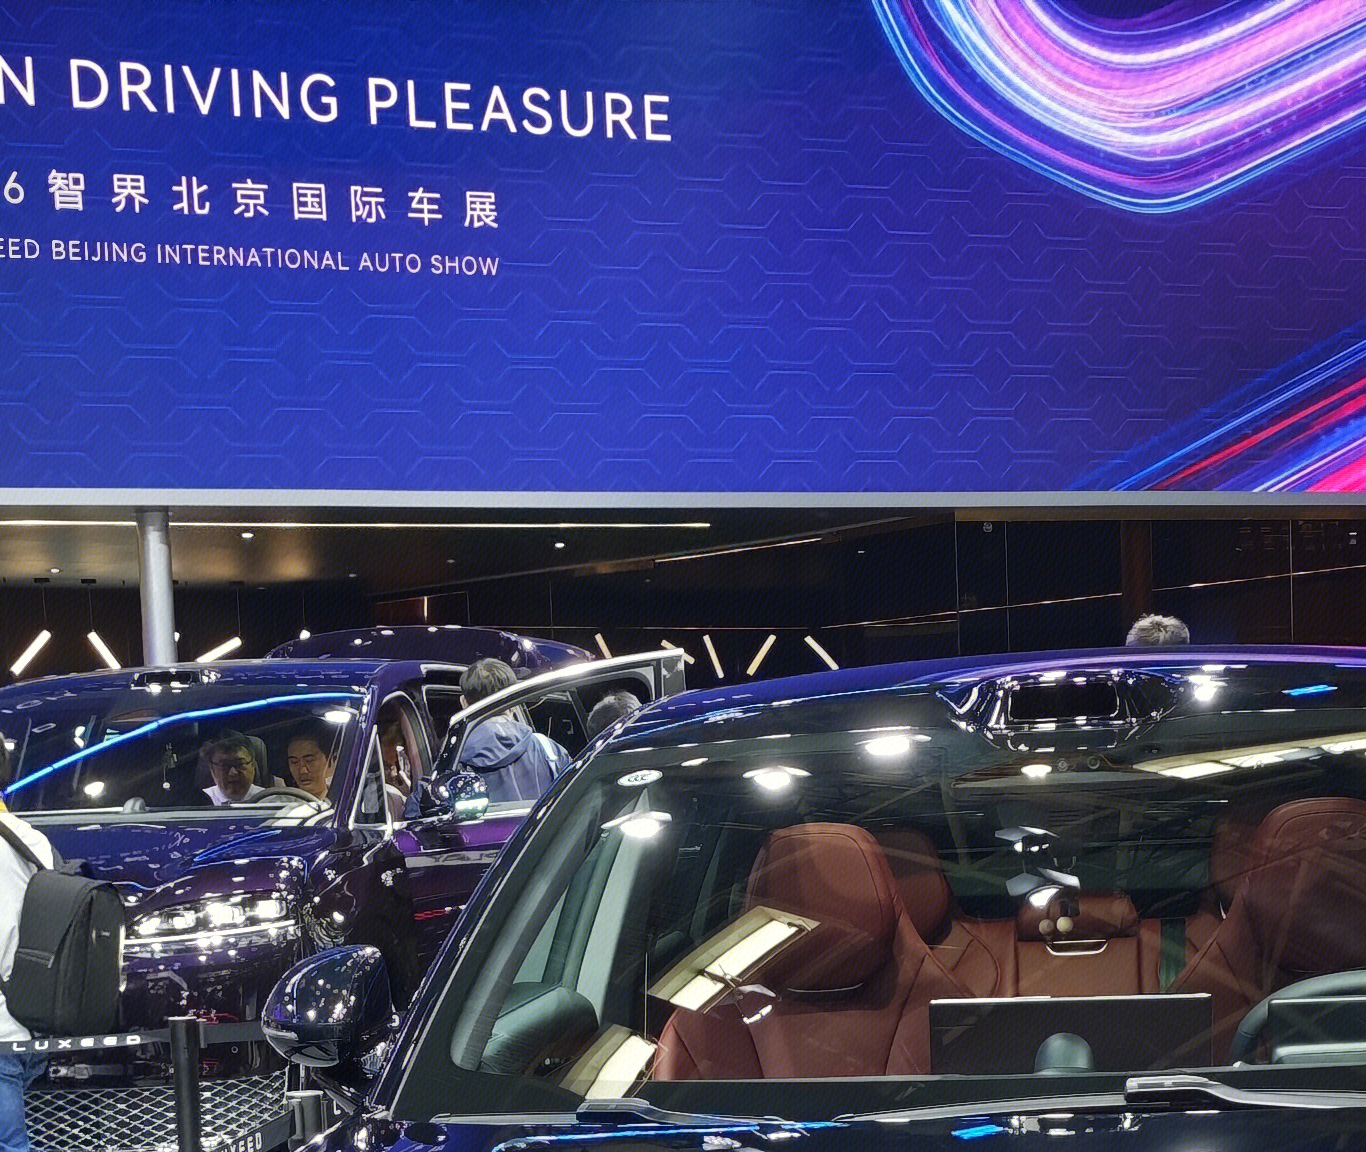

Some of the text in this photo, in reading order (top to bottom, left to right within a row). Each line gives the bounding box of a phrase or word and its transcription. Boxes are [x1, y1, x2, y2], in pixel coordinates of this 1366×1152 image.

[69, 58, 338, 123] DRIVING
[368, 77, 672, 142] PLEASURE
[51, 239, 147, 264] BEIJING
[157, 243, 350, 271] INTERNATIONAL
[358, 252, 421, 274] AUTO
[430, 254, 500, 276] SHOW
[12, 1034, 141, 1053] LUXEED
